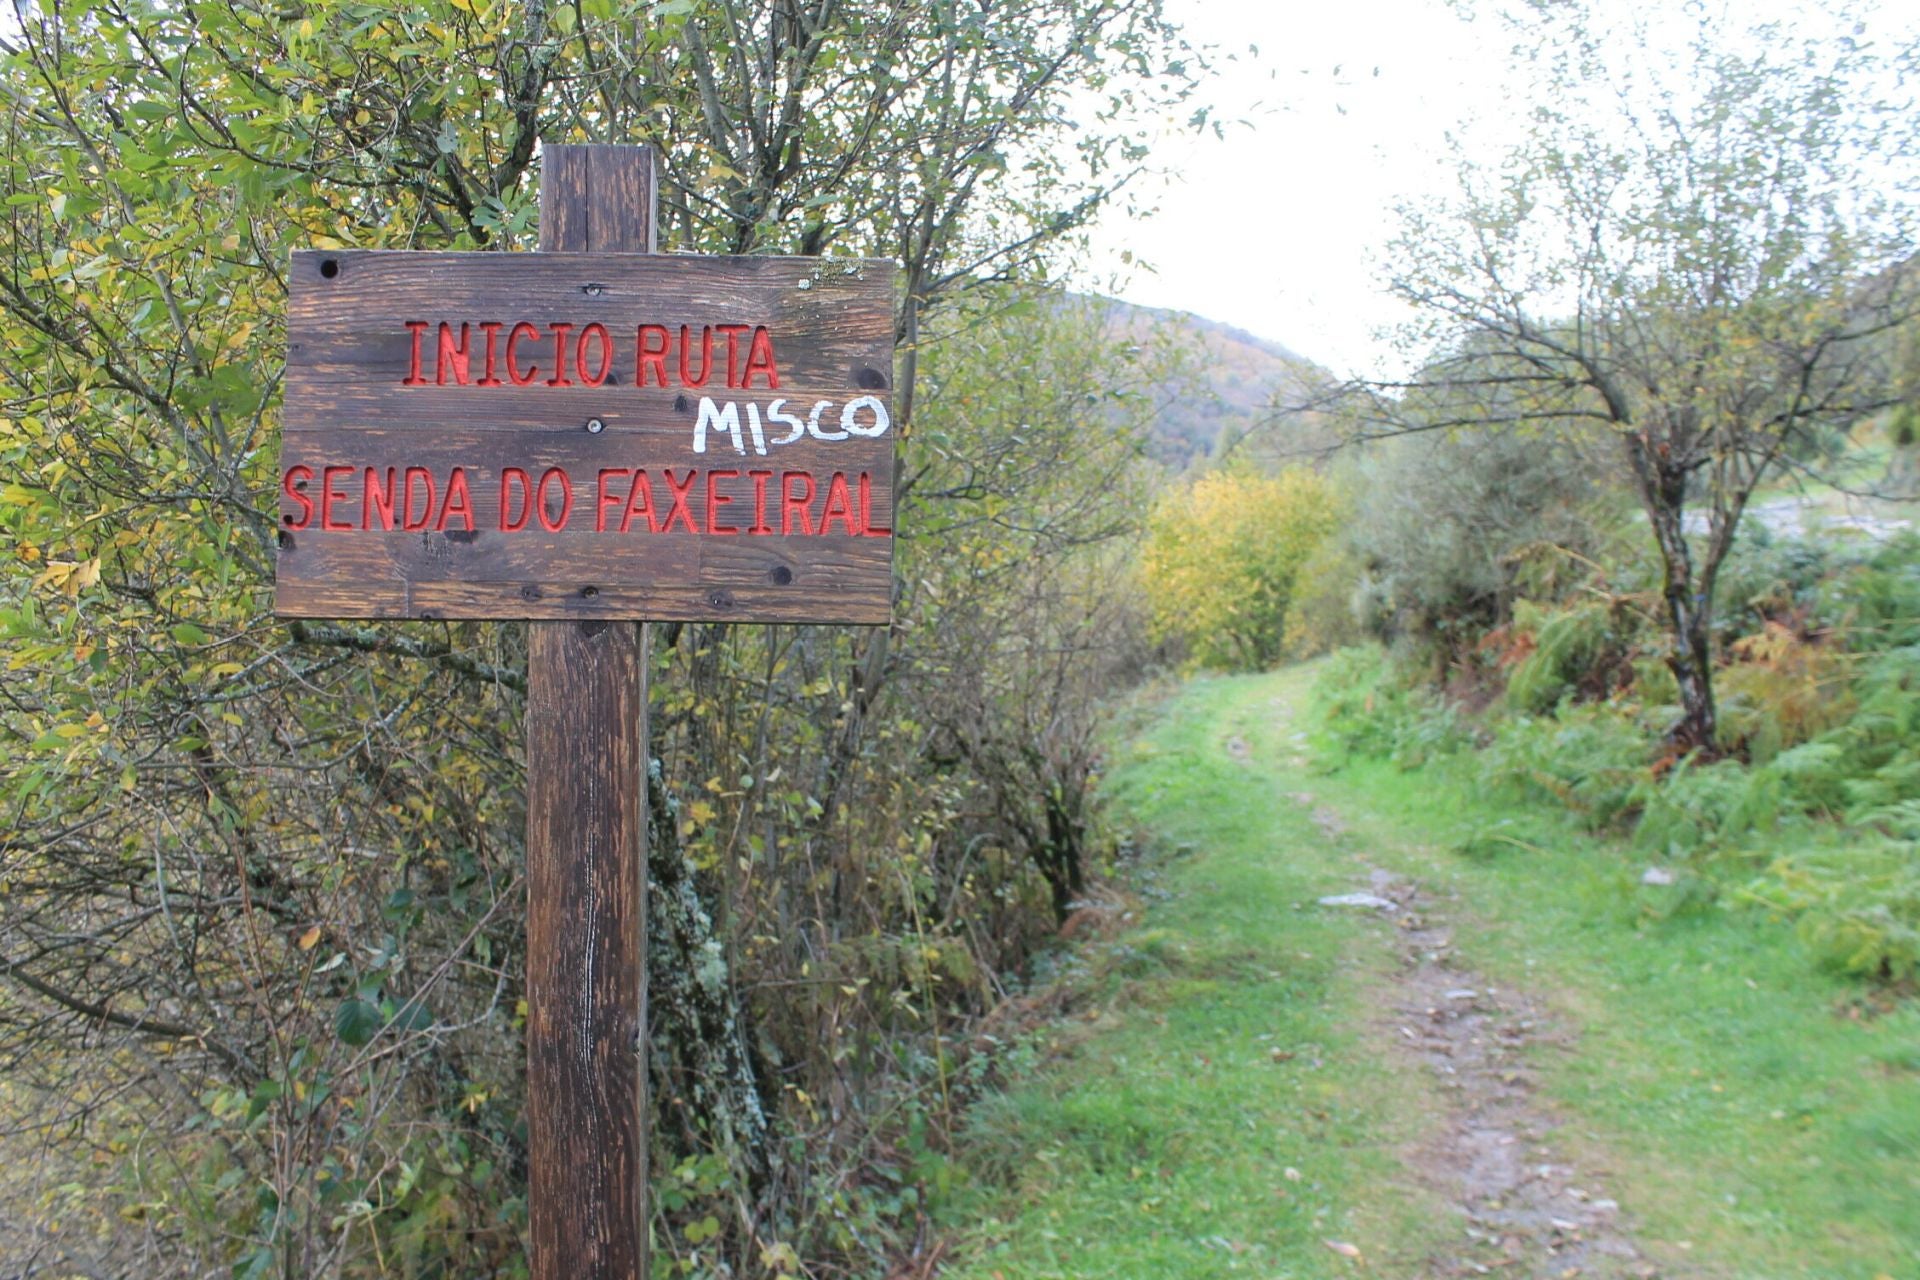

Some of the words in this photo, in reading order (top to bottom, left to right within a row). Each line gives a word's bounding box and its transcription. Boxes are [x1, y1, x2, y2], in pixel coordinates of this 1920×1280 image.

[402, 320, 613, 388] INICIO
[635, 323, 780, 389] RUTA
[692, 394, 891, 457] MISCO
[282, 465, 475, 533] SENDA
[499, 466, 574, 533] DO
[596, 468, 892, 538] FAXEIRAL
